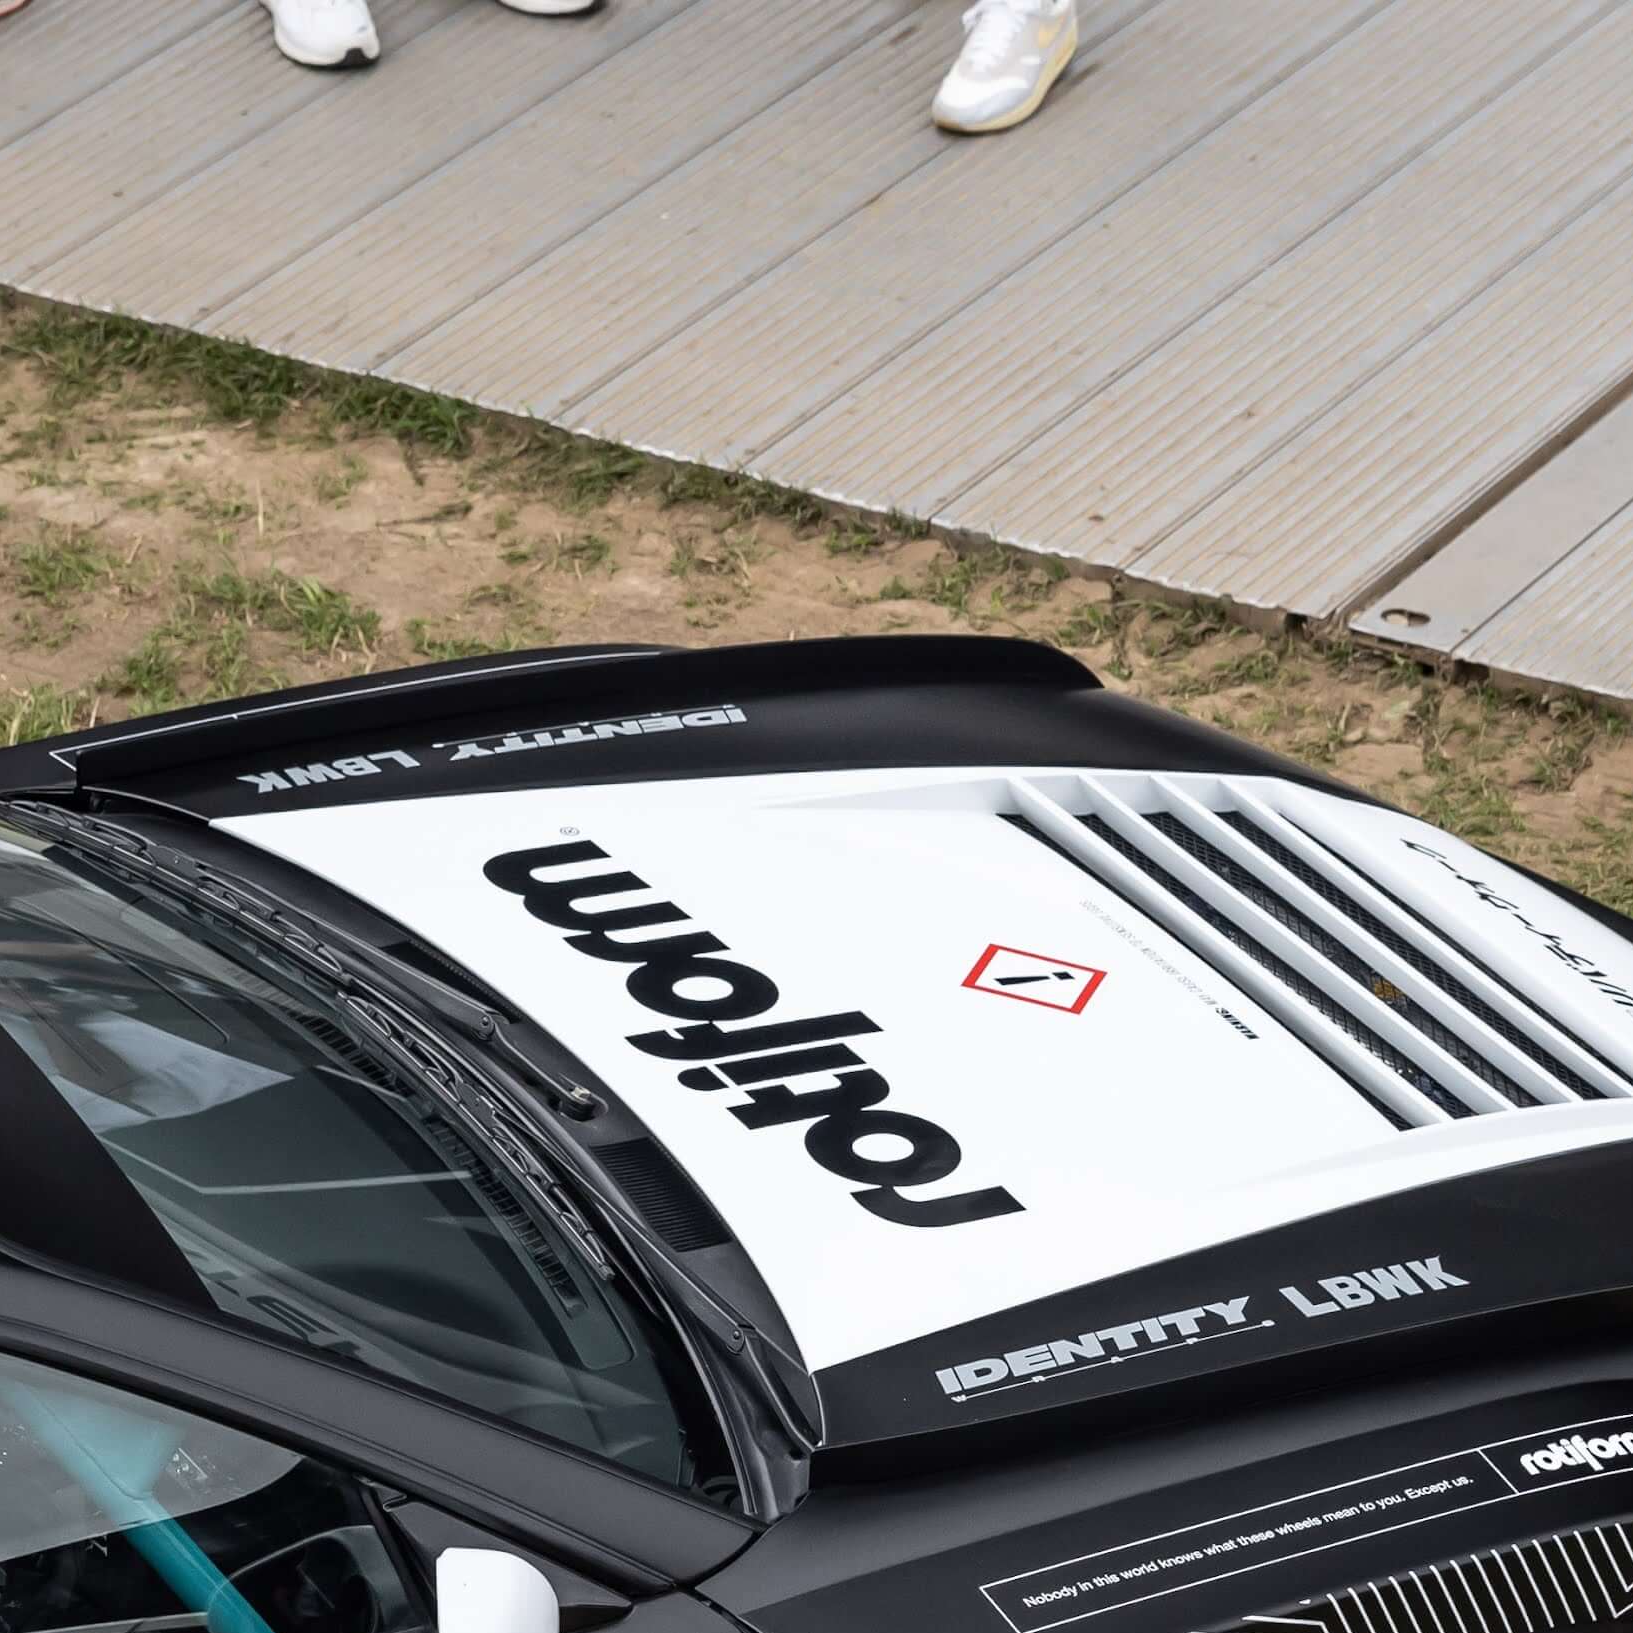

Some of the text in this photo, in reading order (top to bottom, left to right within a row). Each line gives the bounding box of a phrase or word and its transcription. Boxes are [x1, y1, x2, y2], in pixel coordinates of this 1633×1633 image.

[236, 748, 421, 795] LBWK
[450, 706, 747, 760] IDENTITY
[483, 839, 1027, 1228] rotiform
[935, 1296, 1249, 1394] IDENTITY
[1279, 1256, 1469, 1317] LBWK
[1023, 1475, 1475, 1607] Nobody in this world knows what these wheels mean to you. Except us.
